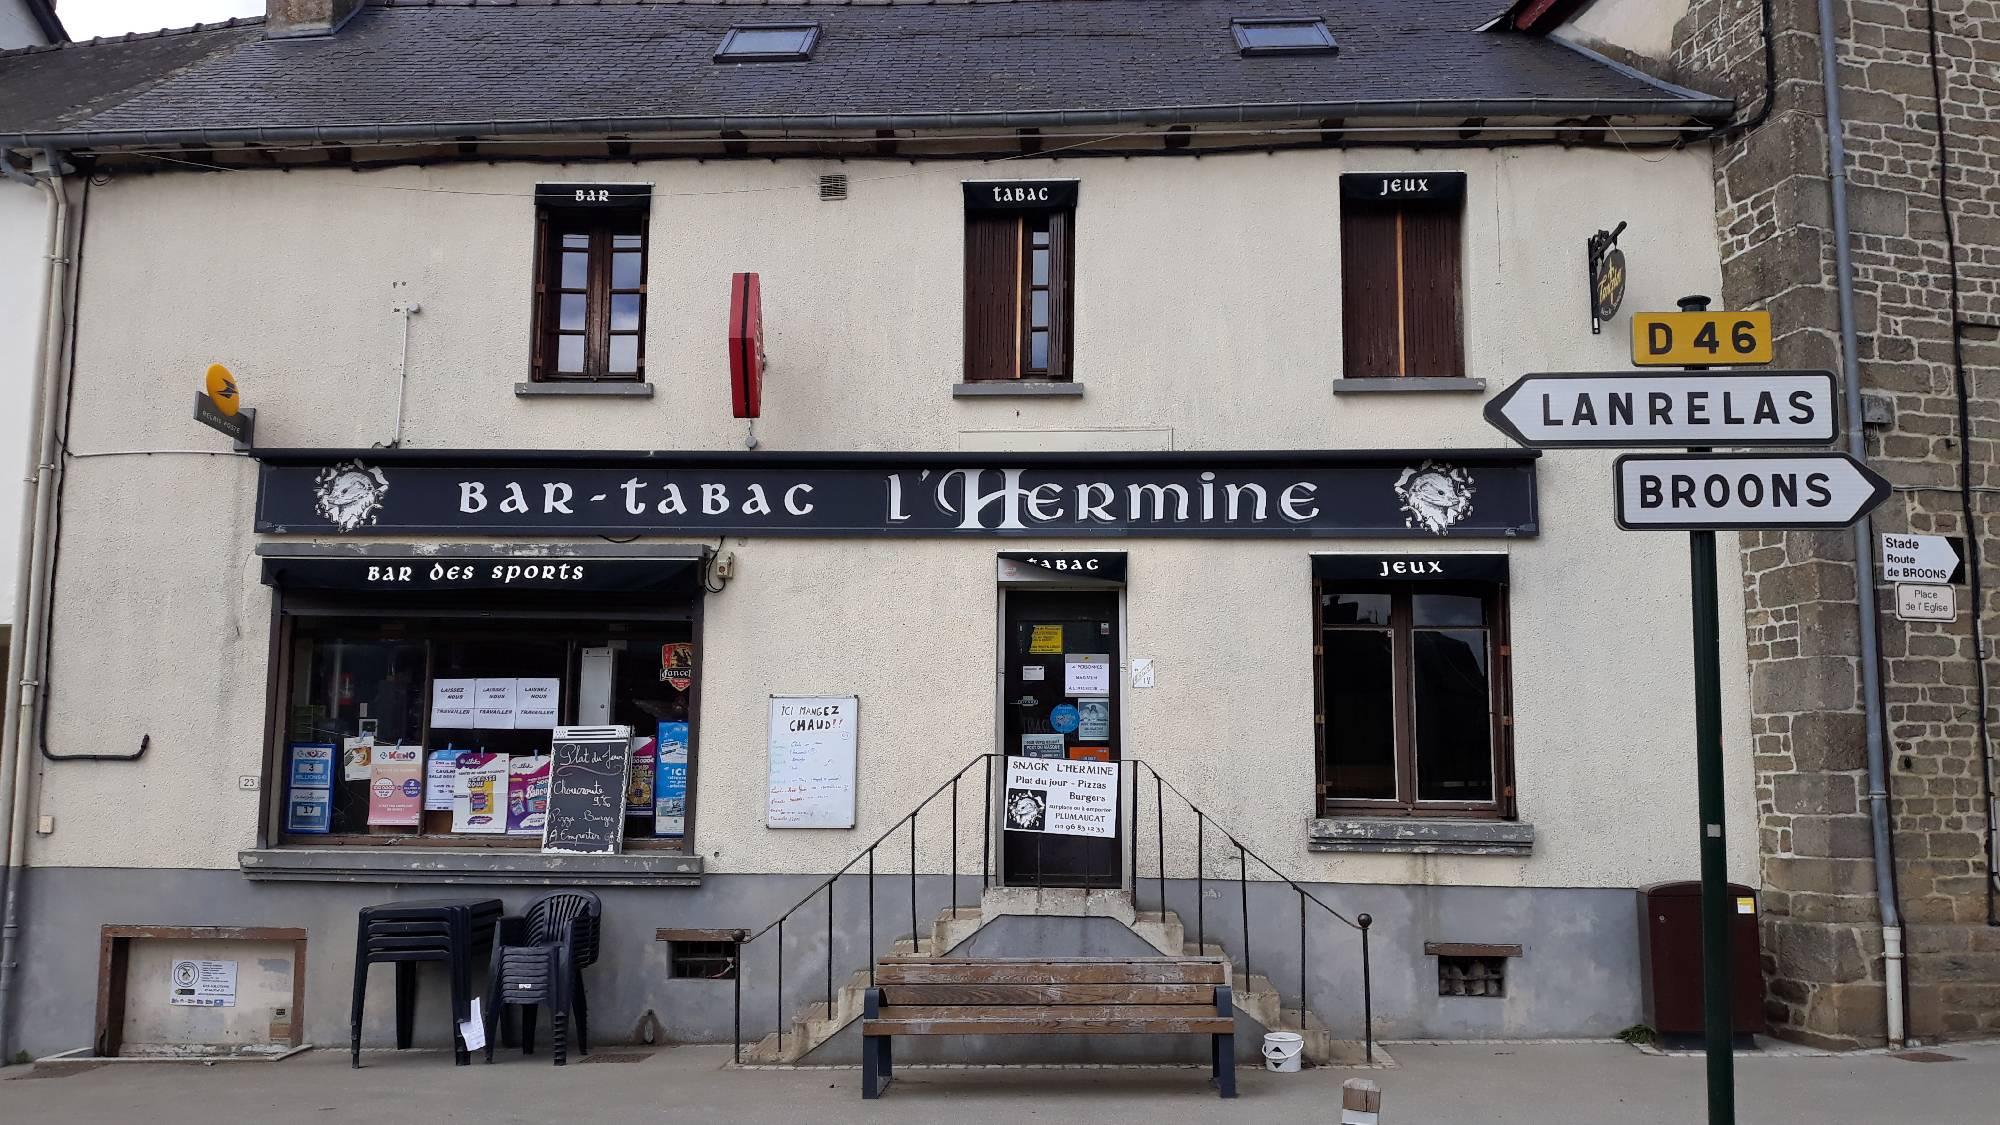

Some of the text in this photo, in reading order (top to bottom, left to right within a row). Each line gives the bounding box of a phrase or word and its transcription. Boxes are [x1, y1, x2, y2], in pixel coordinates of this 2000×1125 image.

[1380, 179, 1428, 195] JEUX
[575, 189, 609, 202] BAR
[993, 186, 1048, 201] TABAC
[1648, 320, 1756, 355] D 46
[1542, 390, 1815, 427] LANRELAS
[1640, 473, 1832, 509] BROONS
[1886, 537, 1919, 549] Stade
[1887, 554, 1915, 563] Route
[367, 566, 412, 581] BAR
[1380, 561, 1443, 576] JEUX
[1887, 567, 1946, 578] de BROONS
[1914, 590, 1937, 598] Place
[1906, 603, 1915, 611] de
[1924, 602, 1948, 613] Eglise
[800, 706, 839, 716] MANGEZ
[388, 750, 416, 759] KENO
[560, 743, 588, 765] Plat
[592, 748, 601, 763] du
[671, 768, 686, 776] ICI
[1012, 760, 1049, 772] SNACK
[244, 778, 254, 786] 23
[1015, 775, 1033, 784] Plat
[1035, 777, 1047, 785] du
[1049, 778, 1068, 787] jour
[1077, 780, 1107, 790] Pizzas
[1069, 791, 1106, 803] Burgers
[549, 808, 575, 827] Pizza
[1065, 823, 1076, 831] 96
[560, 828, 600, 846] Emporter
